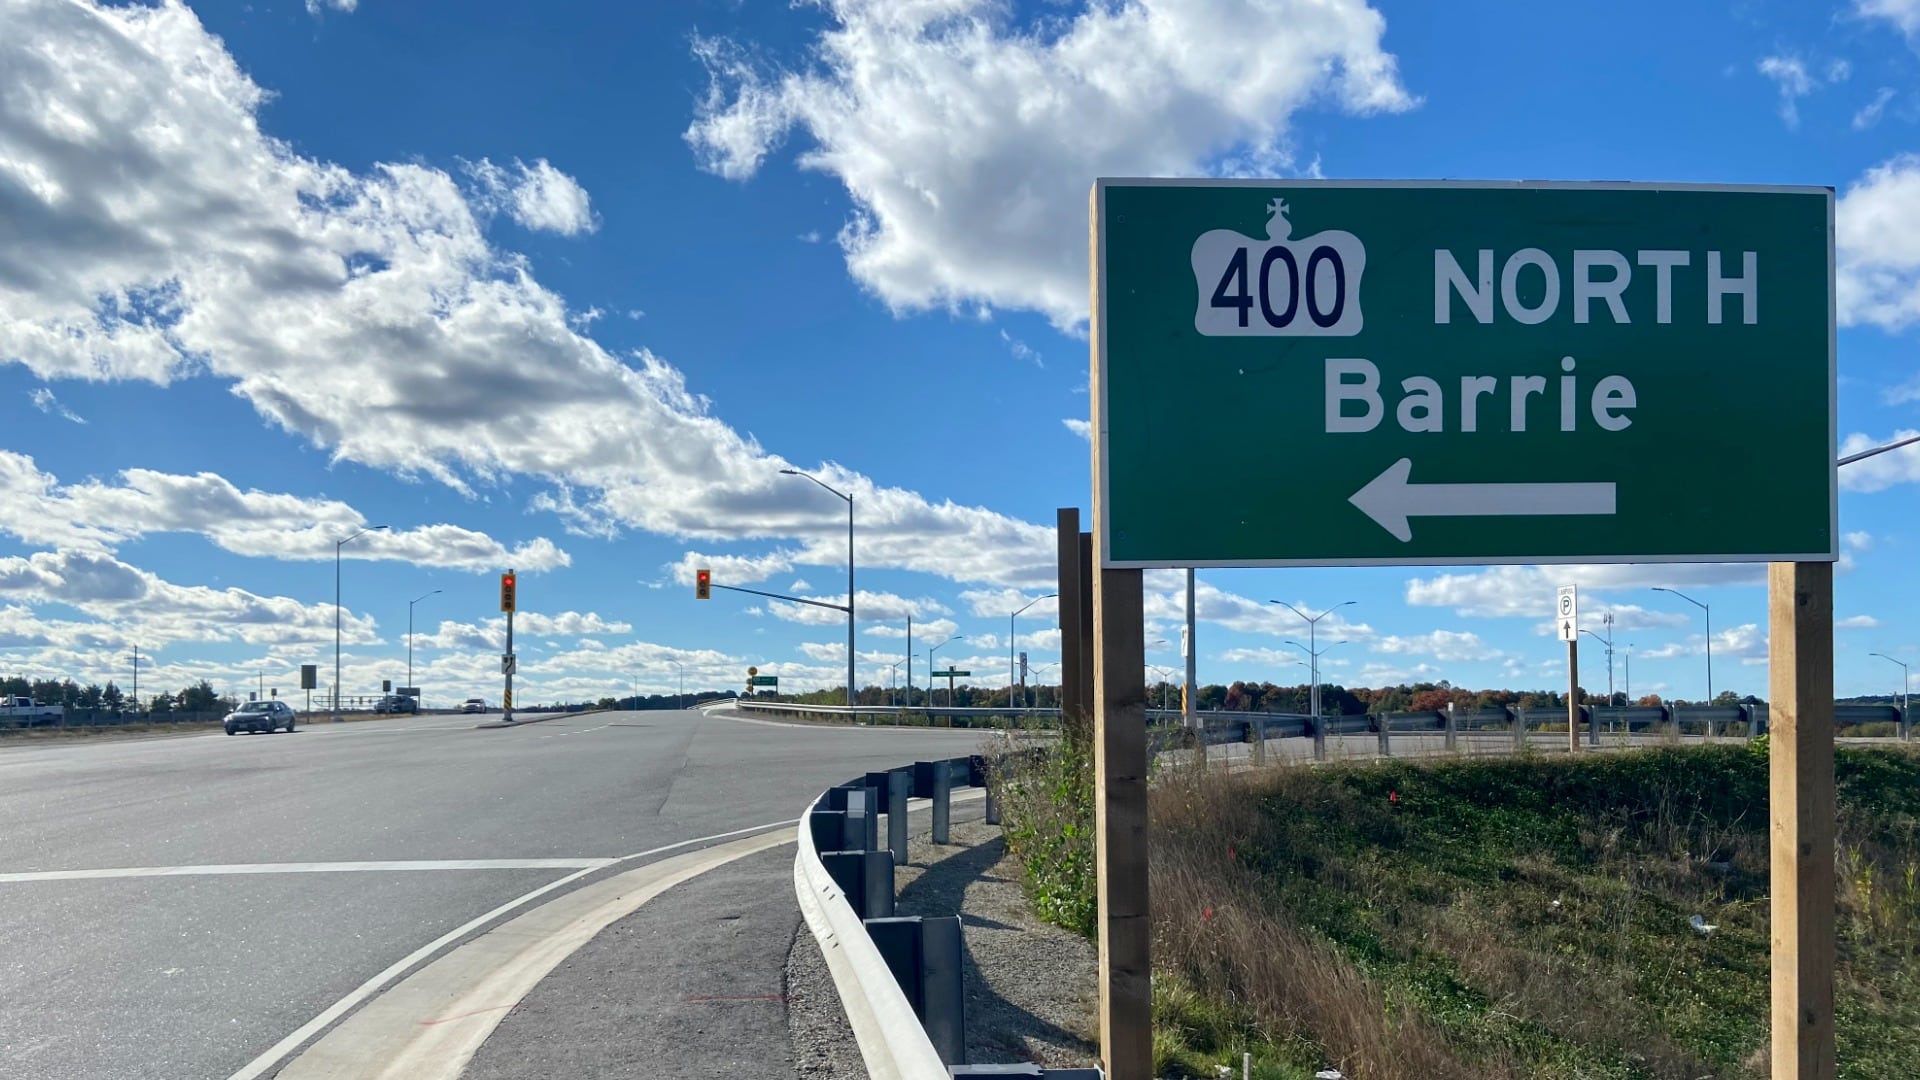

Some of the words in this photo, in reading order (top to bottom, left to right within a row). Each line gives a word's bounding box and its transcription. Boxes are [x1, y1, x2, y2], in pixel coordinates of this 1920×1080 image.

[1211, 245, 1347, 329] 400
[1434, 247, 1758, 325] NORTH
[1324, 356, 1637, 434] Barrie
